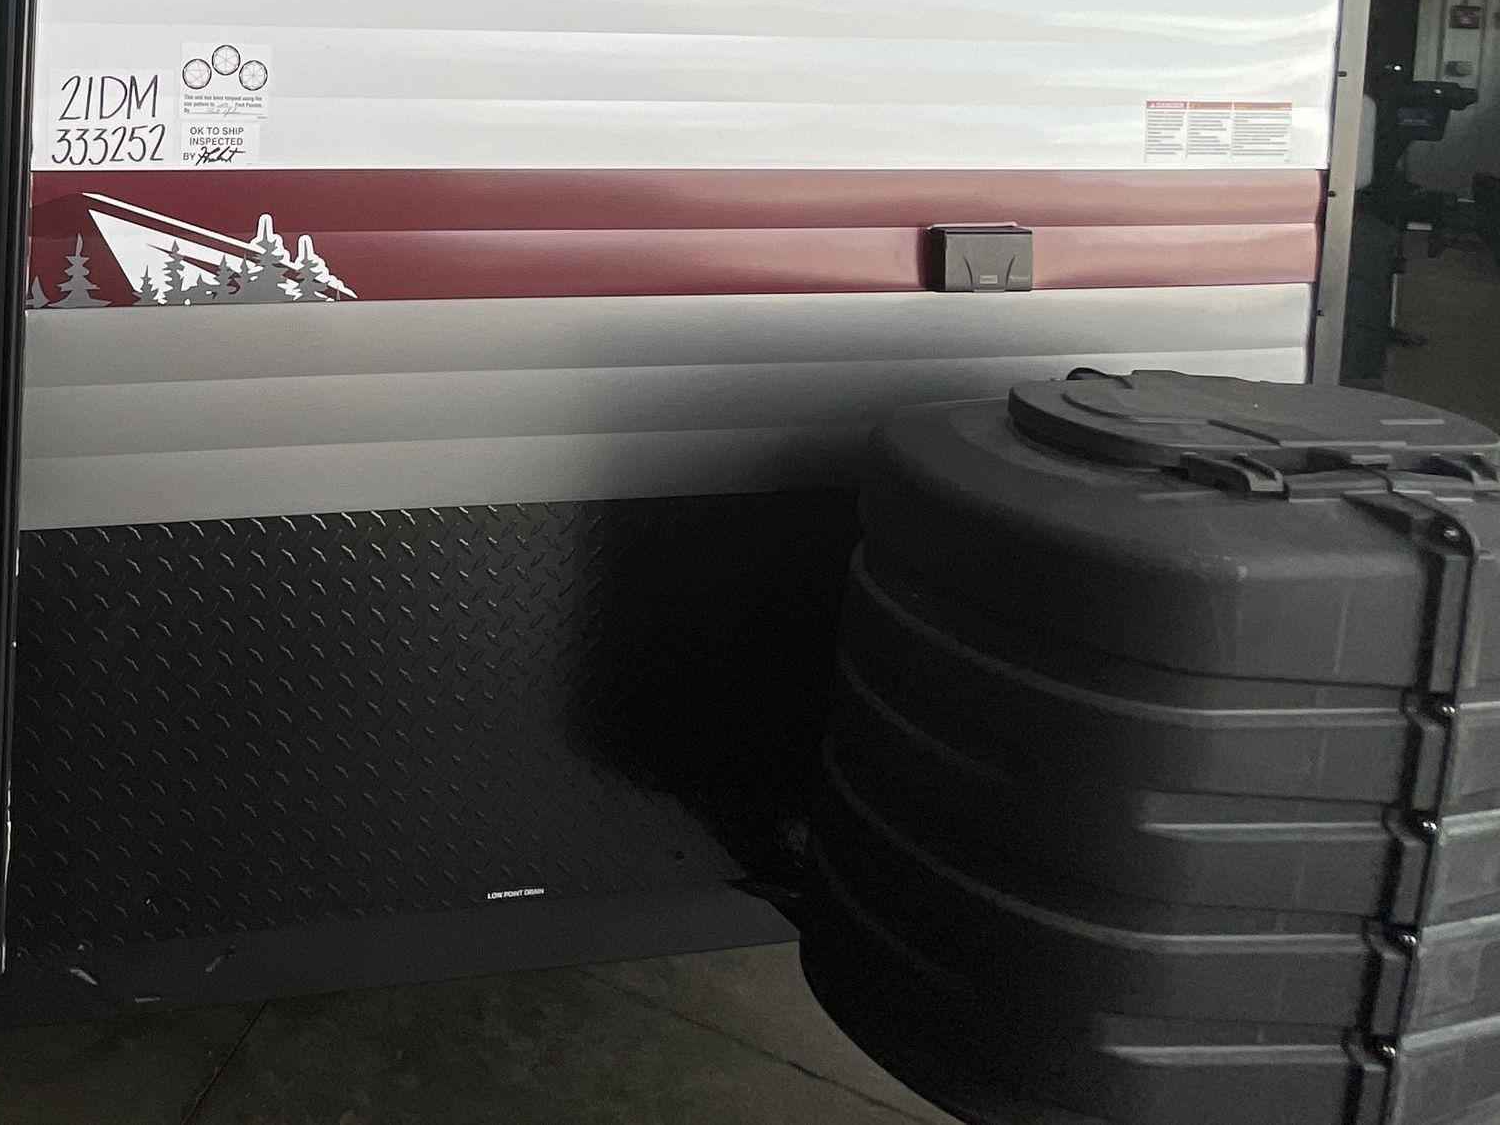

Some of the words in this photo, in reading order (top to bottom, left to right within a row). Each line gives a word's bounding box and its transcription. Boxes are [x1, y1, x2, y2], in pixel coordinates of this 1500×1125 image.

[189, 126, 205, 136] OK
[206, 126, 220, 136] TO
[222, 126, 244, 136] SHIP
[51, 124, 166, 166] 333252
[189, 137, 244, 146] INSPECTED
[182, 152, 196, 161] BY
